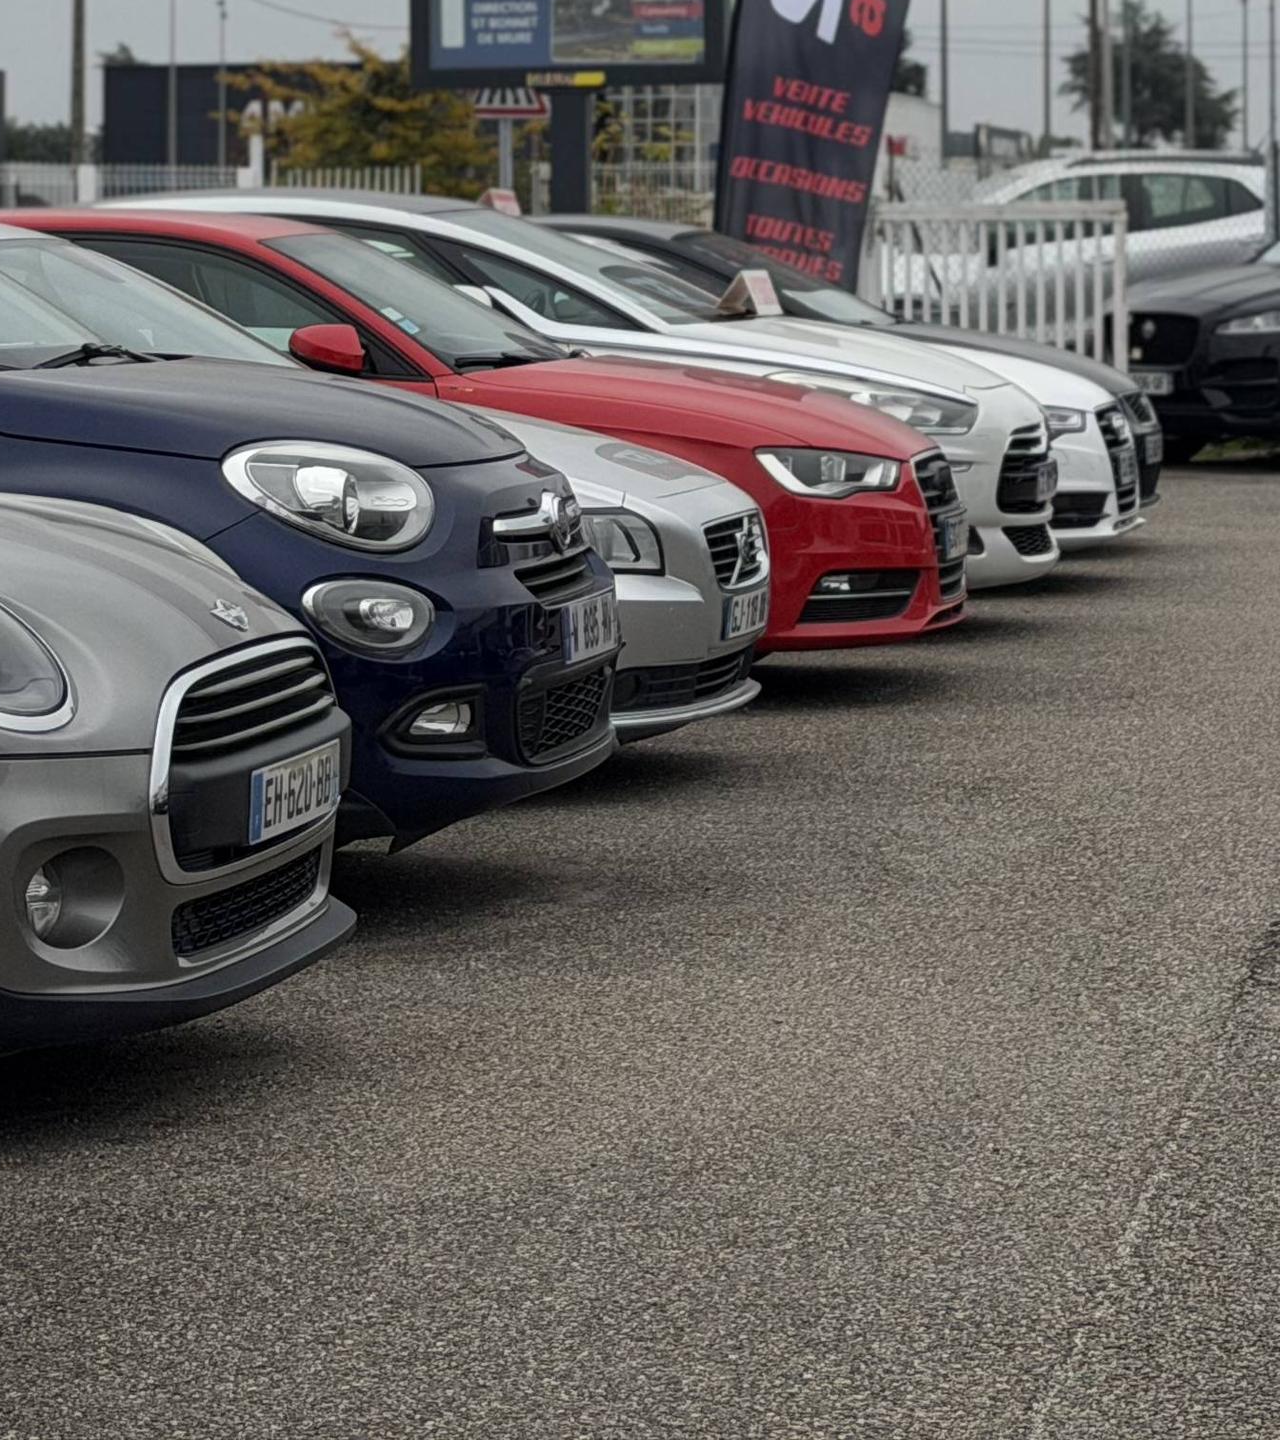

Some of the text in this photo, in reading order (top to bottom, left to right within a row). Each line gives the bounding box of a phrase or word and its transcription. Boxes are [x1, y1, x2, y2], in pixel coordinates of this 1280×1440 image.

[773, 75, 851, 113] VENTE
[730, 156, 868, 204] OCCASIONS
[746, 213, 835, 251] TOUTES
